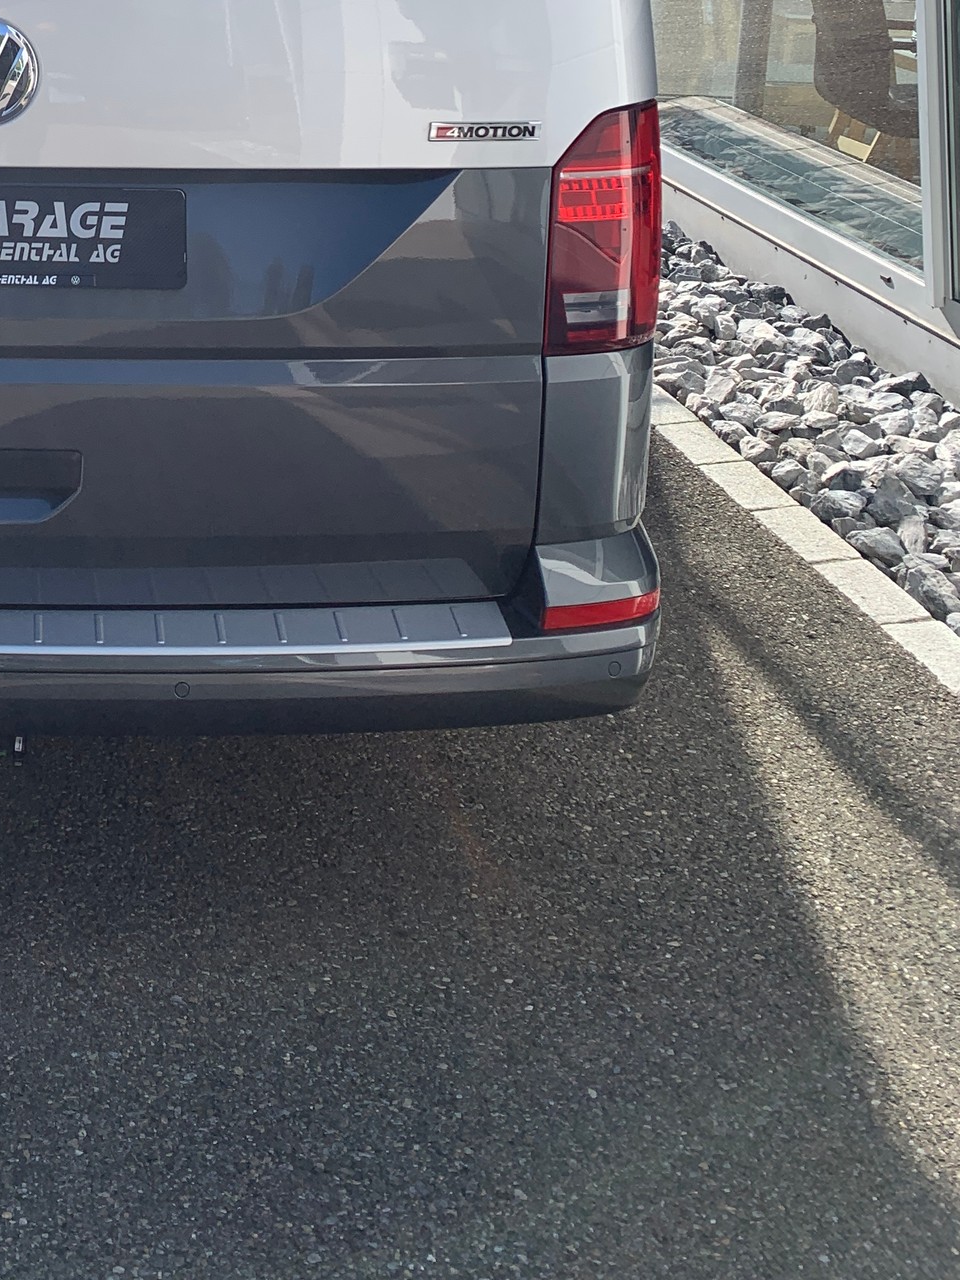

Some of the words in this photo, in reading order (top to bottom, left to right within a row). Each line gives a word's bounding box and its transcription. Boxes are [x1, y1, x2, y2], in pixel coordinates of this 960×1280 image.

[446, 125, 536, 138] 4MOTION
[89, 243, 123, 264] AG
[41, 275, 58, 285] AG
